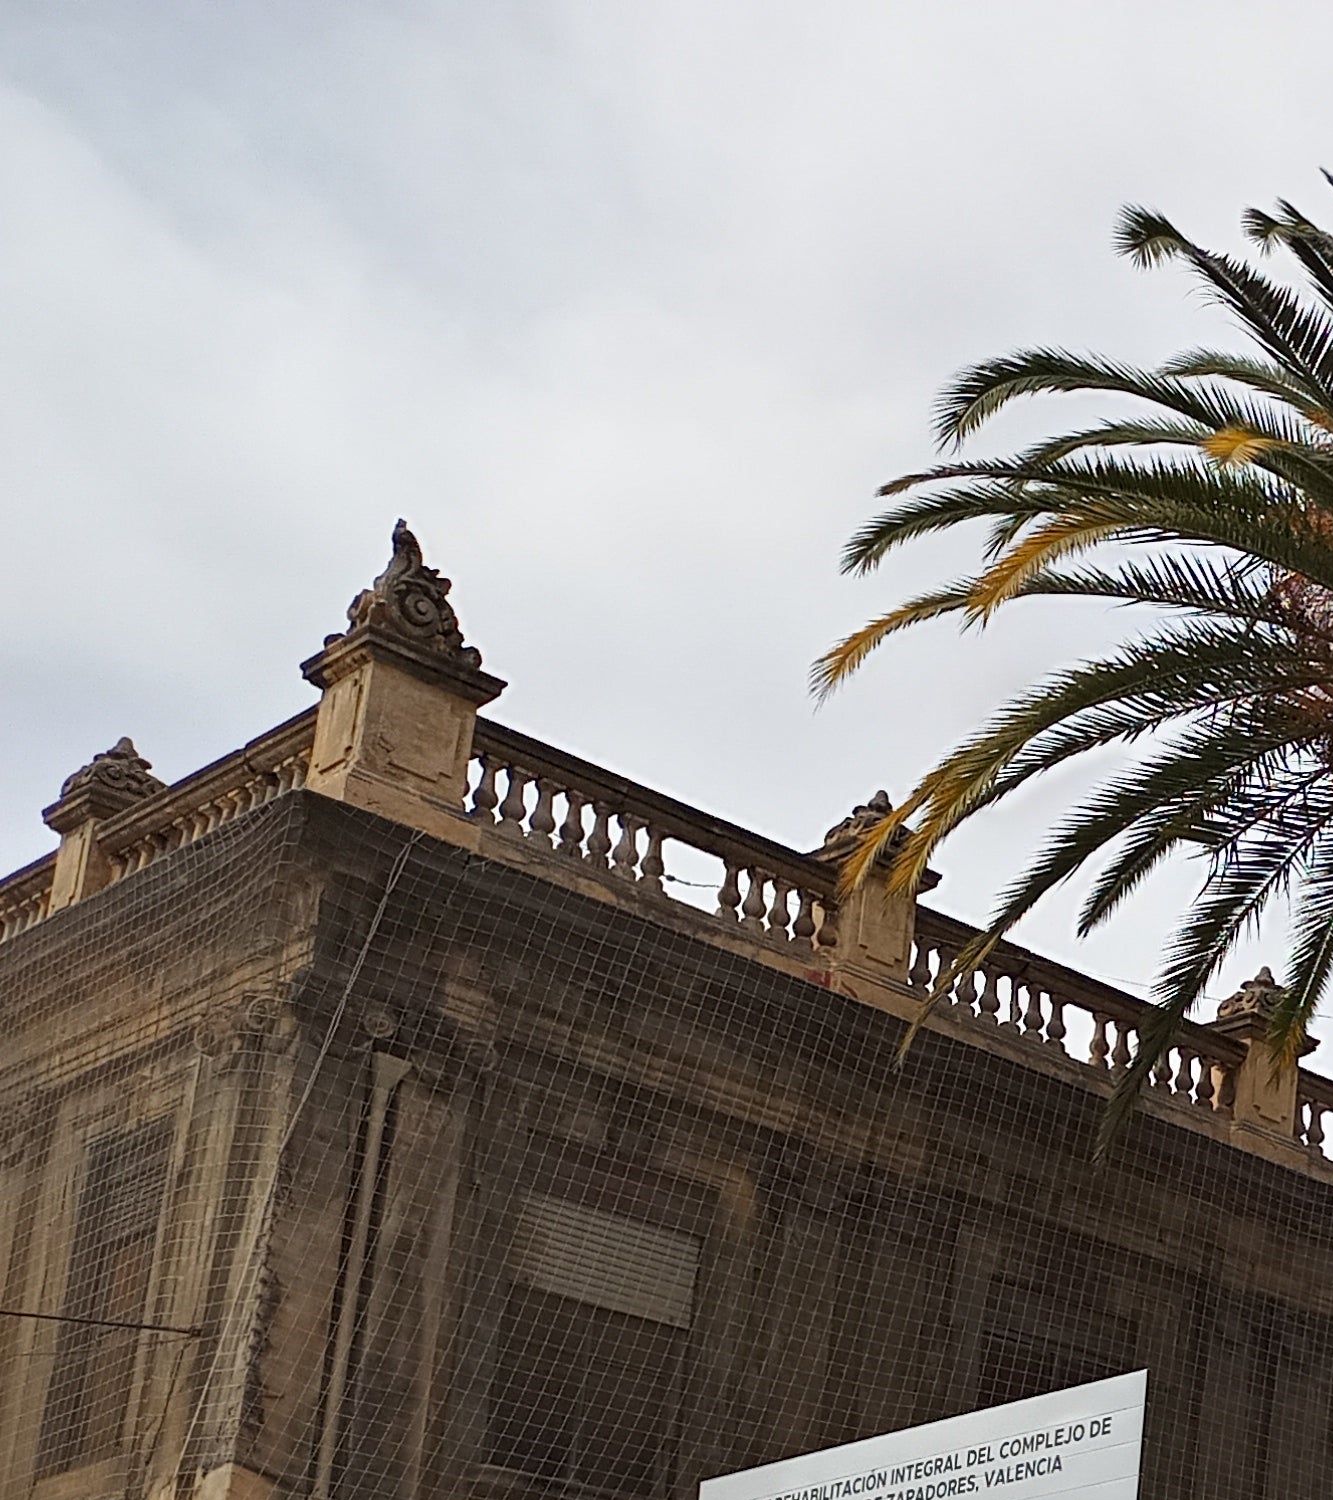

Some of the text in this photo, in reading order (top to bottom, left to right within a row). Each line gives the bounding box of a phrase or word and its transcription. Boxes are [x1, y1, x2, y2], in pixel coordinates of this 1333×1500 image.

[890, 1453, 962, 1486] INTEGRAL
[966, 1446, 995, 1467] DEL
[999, 1423, 1086, 1459] COMPLEJO
[1089, 1416, 1113, 1439] DE
[984, 1454, 1063, 1488] VALENCIA
